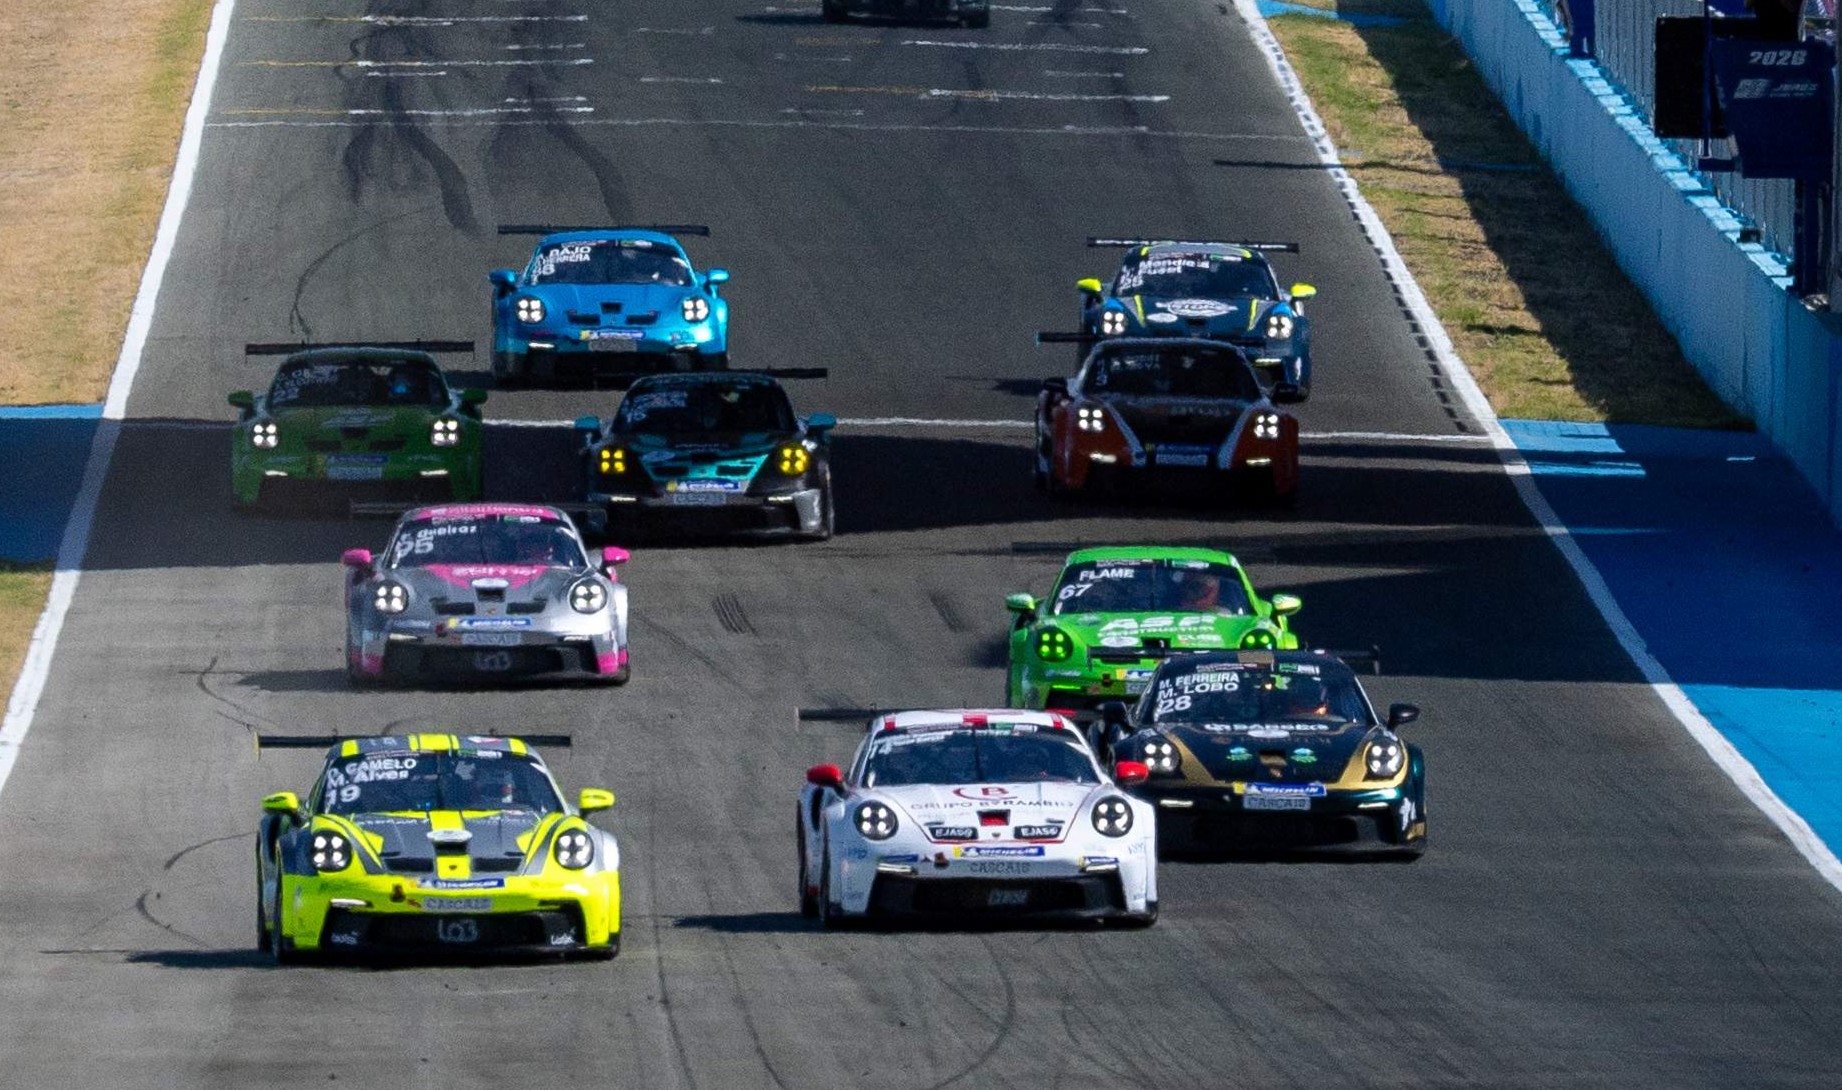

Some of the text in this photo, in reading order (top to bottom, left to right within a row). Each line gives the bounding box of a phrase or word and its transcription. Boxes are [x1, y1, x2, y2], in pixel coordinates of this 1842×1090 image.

[1079, 568, 1135, 581] FLAME
[1058, 583, 1092, 600] 67
[1175, 672, 1240, 687] FERREIRA
[1184, 682, 1239, 694] LOBO
[1159, 695, 1192, 715] 28
[345, 758, 417, 775] CAMELO
[910, 801, 974, 811] GRUPO
